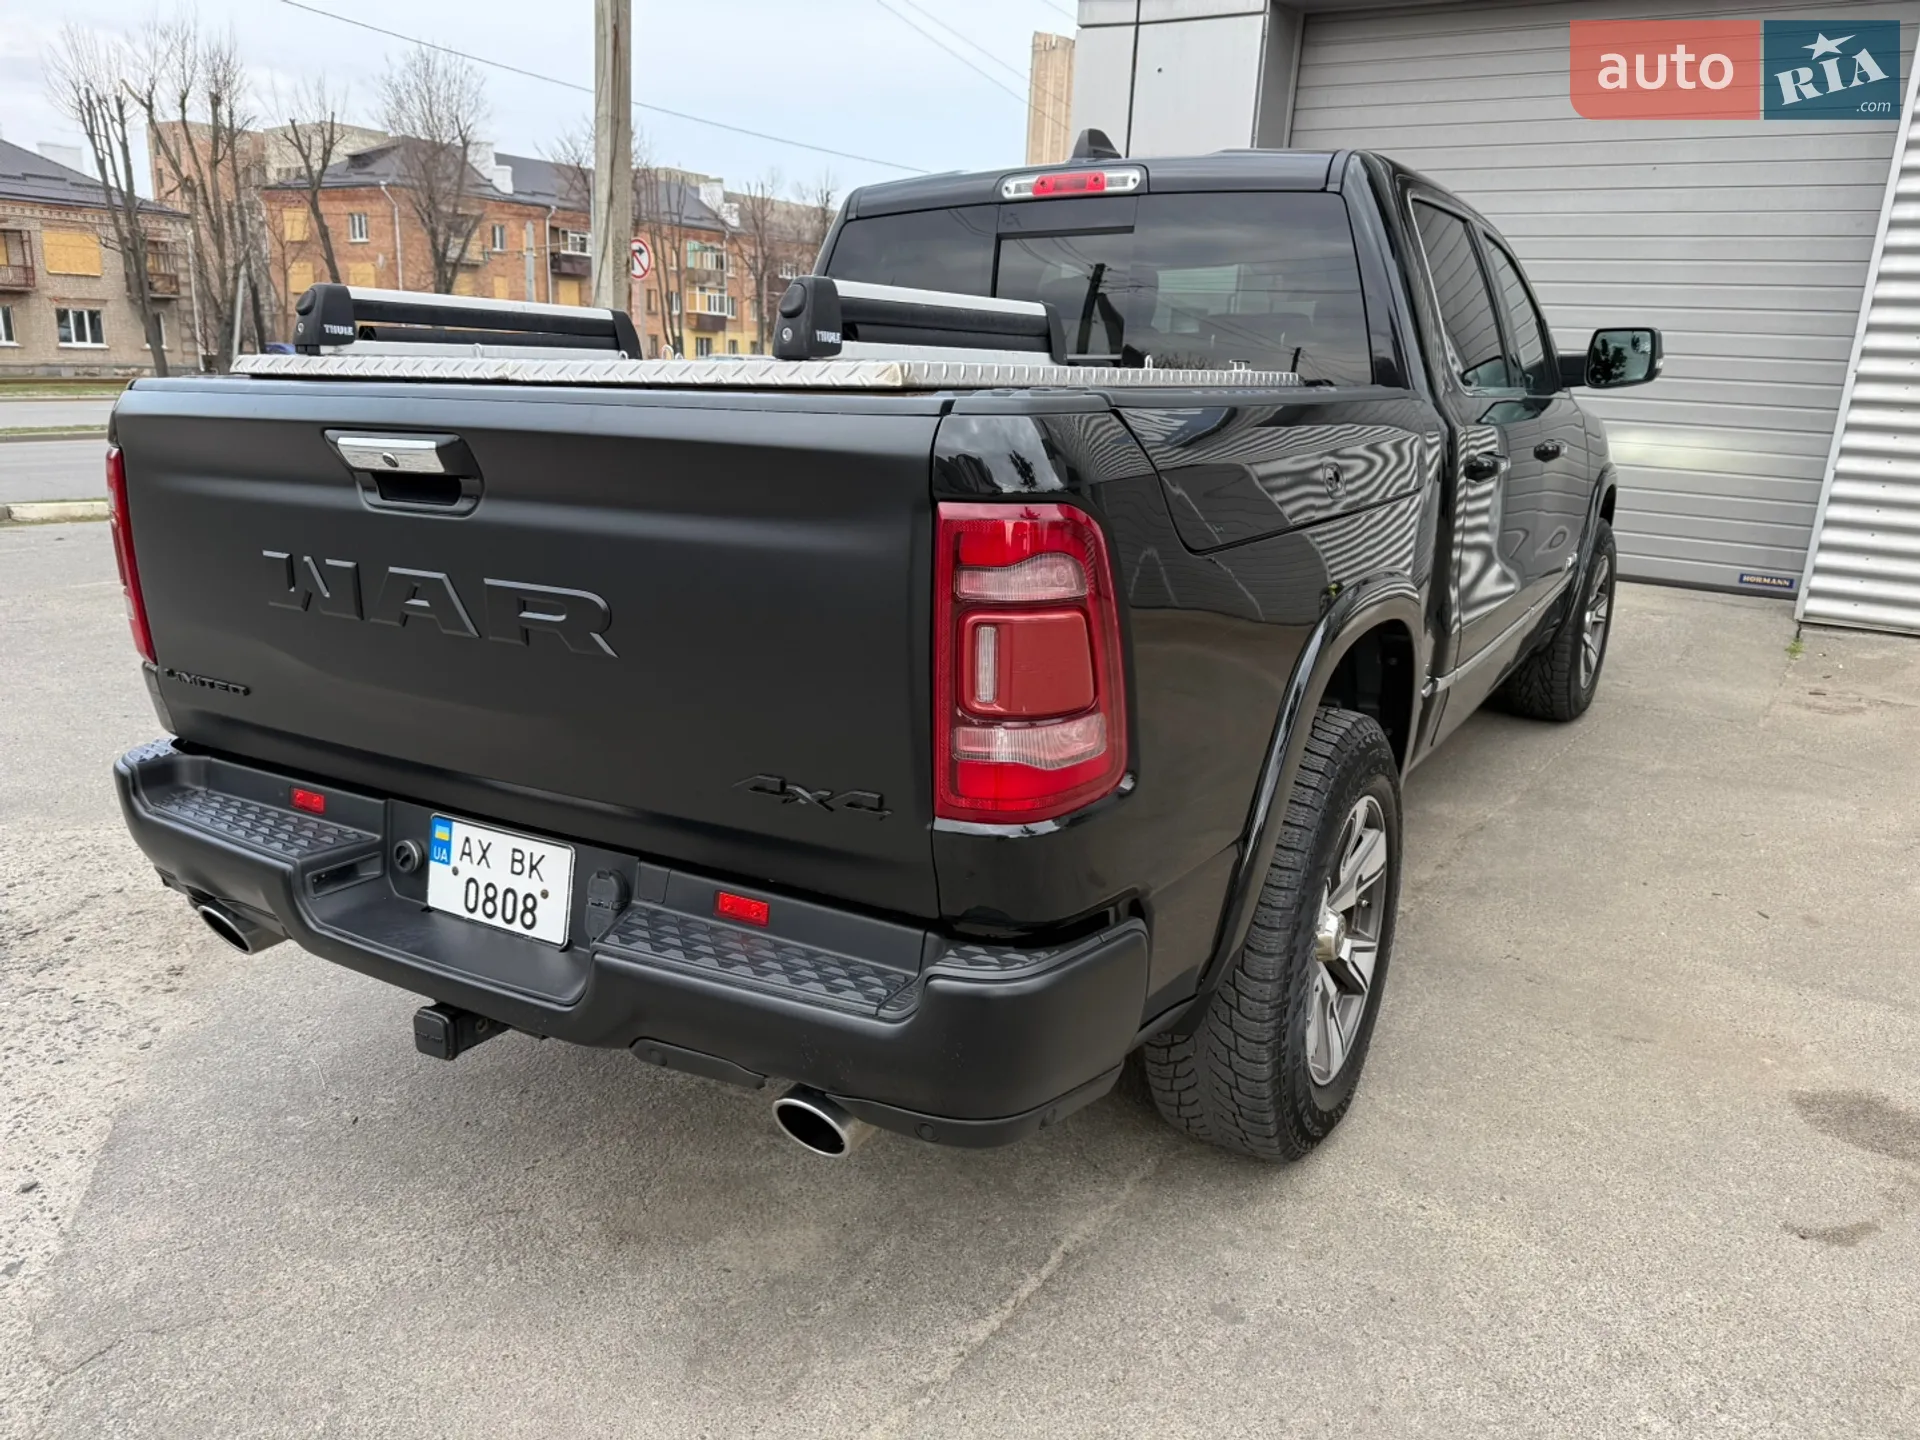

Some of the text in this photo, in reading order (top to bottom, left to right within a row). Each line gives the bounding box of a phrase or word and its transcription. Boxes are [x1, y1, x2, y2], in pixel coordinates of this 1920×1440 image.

[323, 324, 354, 336] THULE
[164, 668, 250, 696] LIMITED
[433, 846, 449, 862] UA
[459, 836, 546, 882] AX BK
[464, 877, 538, 930] 0808
